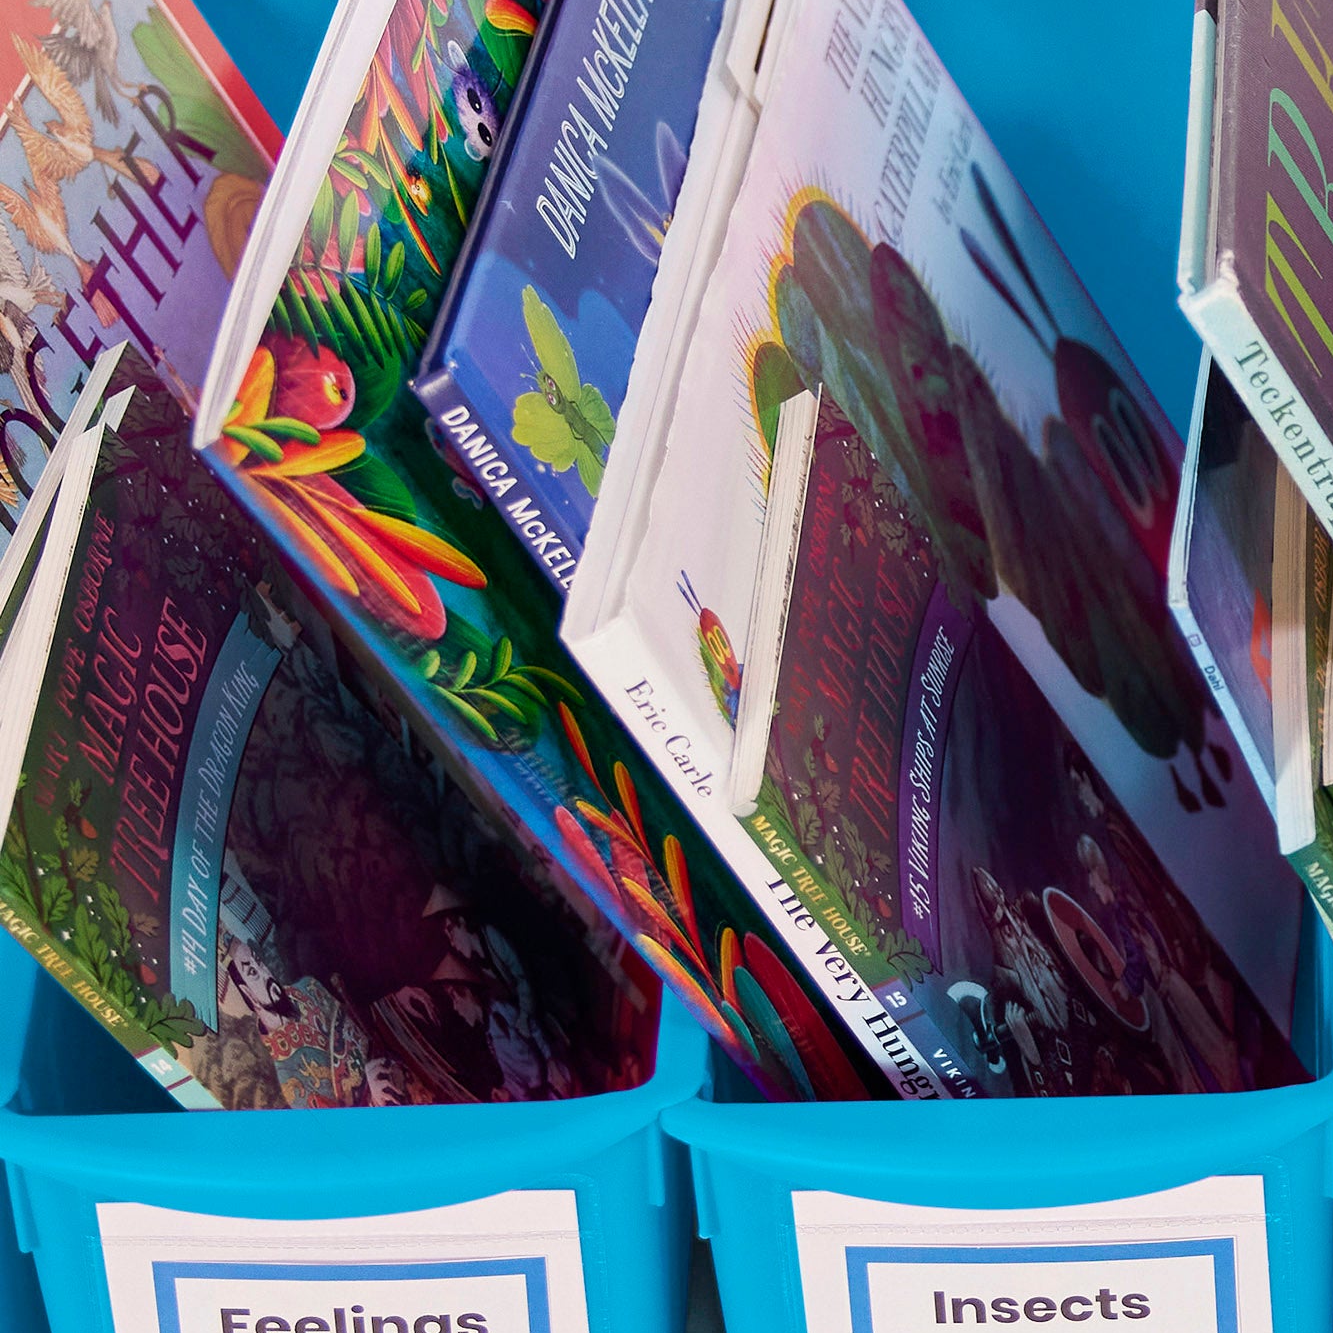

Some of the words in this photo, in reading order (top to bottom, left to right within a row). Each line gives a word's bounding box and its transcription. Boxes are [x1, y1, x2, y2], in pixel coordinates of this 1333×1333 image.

[536, 102, 608, 260] DANICA
[441, 405, 518, 498] DANICA
[817, 556, 865, 725] MAGIC
[920, 625, 956, 708] SUNRISE
[76, 604, 142, 787] MAGIC
[136, 595, 208, 780] HOUSE
[221, 659, 260, 719] KING
[918, 692, 939, 735] AT
[198, 705, 240, 792] DRAGON
[624, 677, 666, 733] Eric
[665, 734, 713, 798] Carle
[849, 698, 895, 840] TREE
[909, 728, 937, 804] SHIPS
[109, 752, 170, 905] TREE
[195, 789, 219, 848] THE
[908, 795, 933, 881] VIKING
[190, 841, 212, 880] OF
[751, 815, 798, 866] MAGIC
[791, 866, 829, 907] TREE
[821, 906, 868, 957] HOUSE
[908, 873, 931, 920] #15
[181, 872, 208, 936] DAY
[35, 943, 76, 979] TREE
[72, 980, 125, 1027] HOUSE
[182, 929, 207, 975] #14
[815, 938, 872, 1004] Very
[885, 991, 908, 1008] 15
[933, 1287, 1150, 1324] Insects
